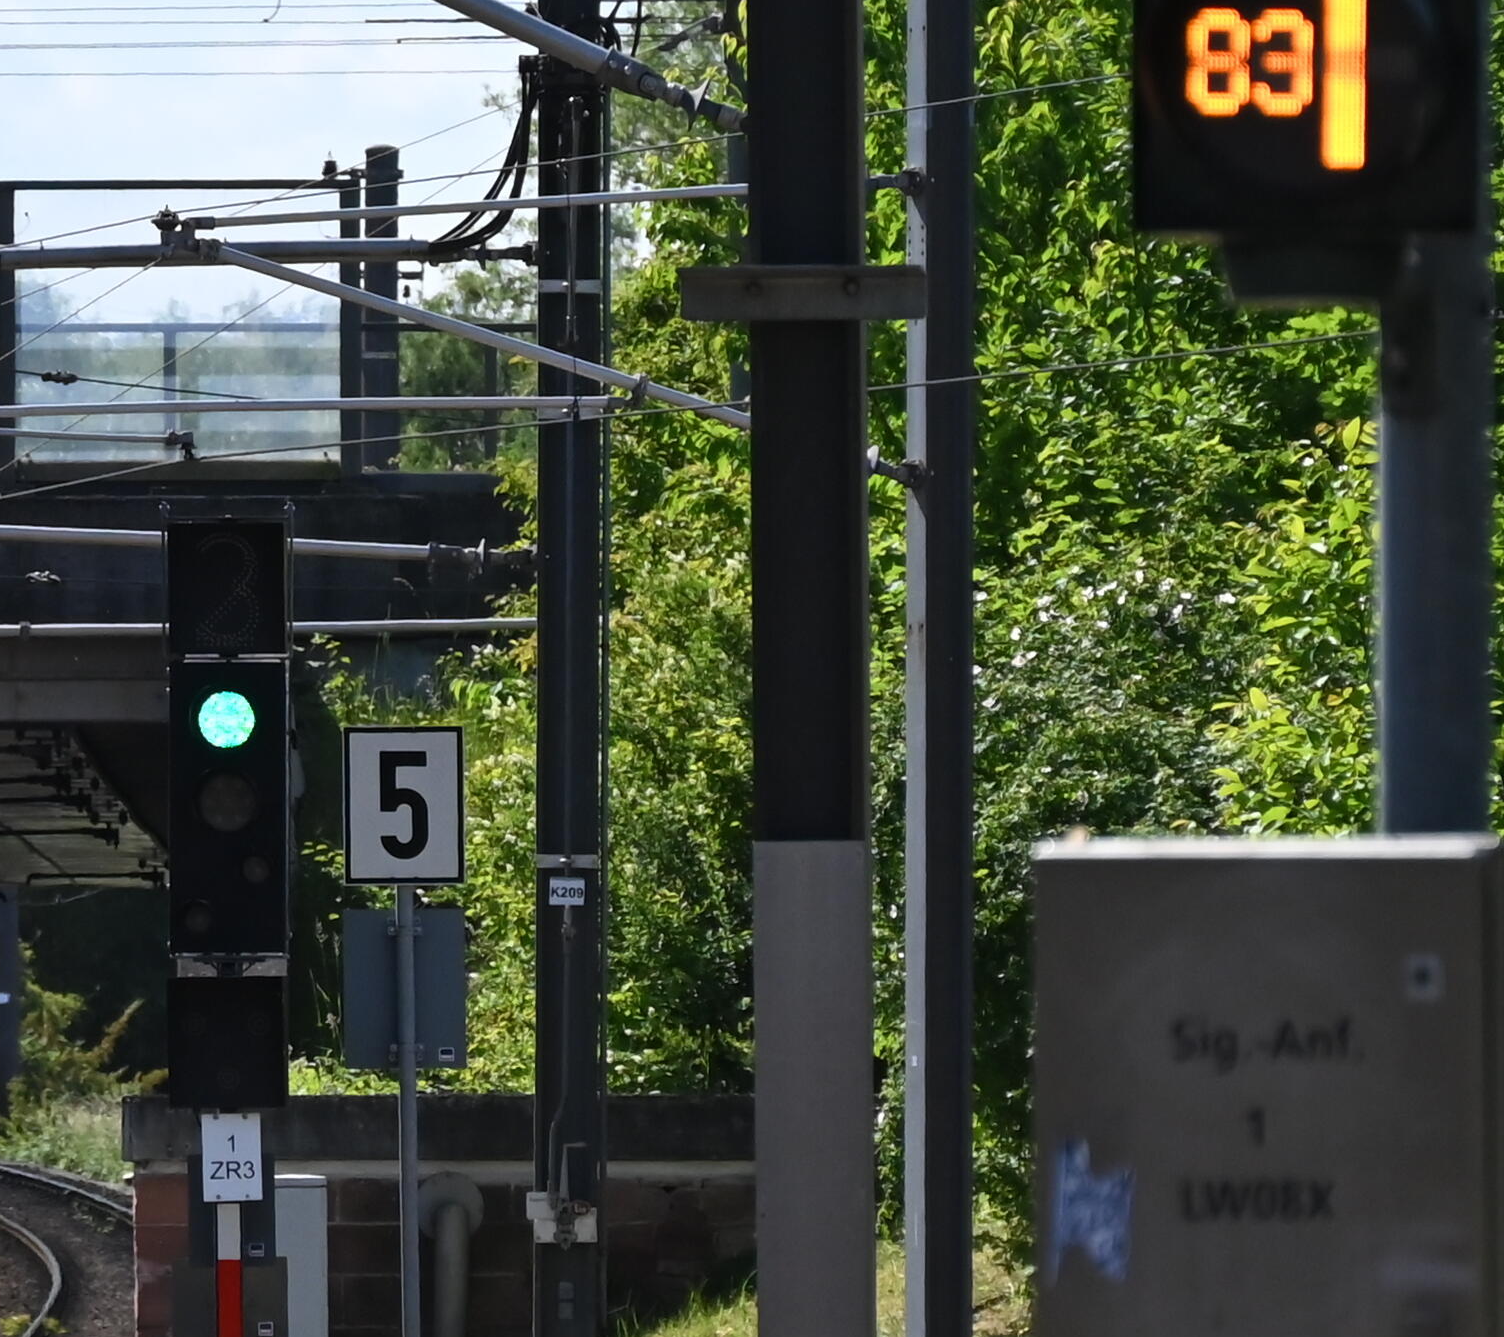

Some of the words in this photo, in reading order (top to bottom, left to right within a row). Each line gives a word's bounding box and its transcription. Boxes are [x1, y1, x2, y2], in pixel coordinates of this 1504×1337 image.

[379, 750, 429, 860] 5
[551, 886, 584, 899] K209
[227, 1134, 235, 1153] 1
[210, 1160, 255, 1180] ZR3
